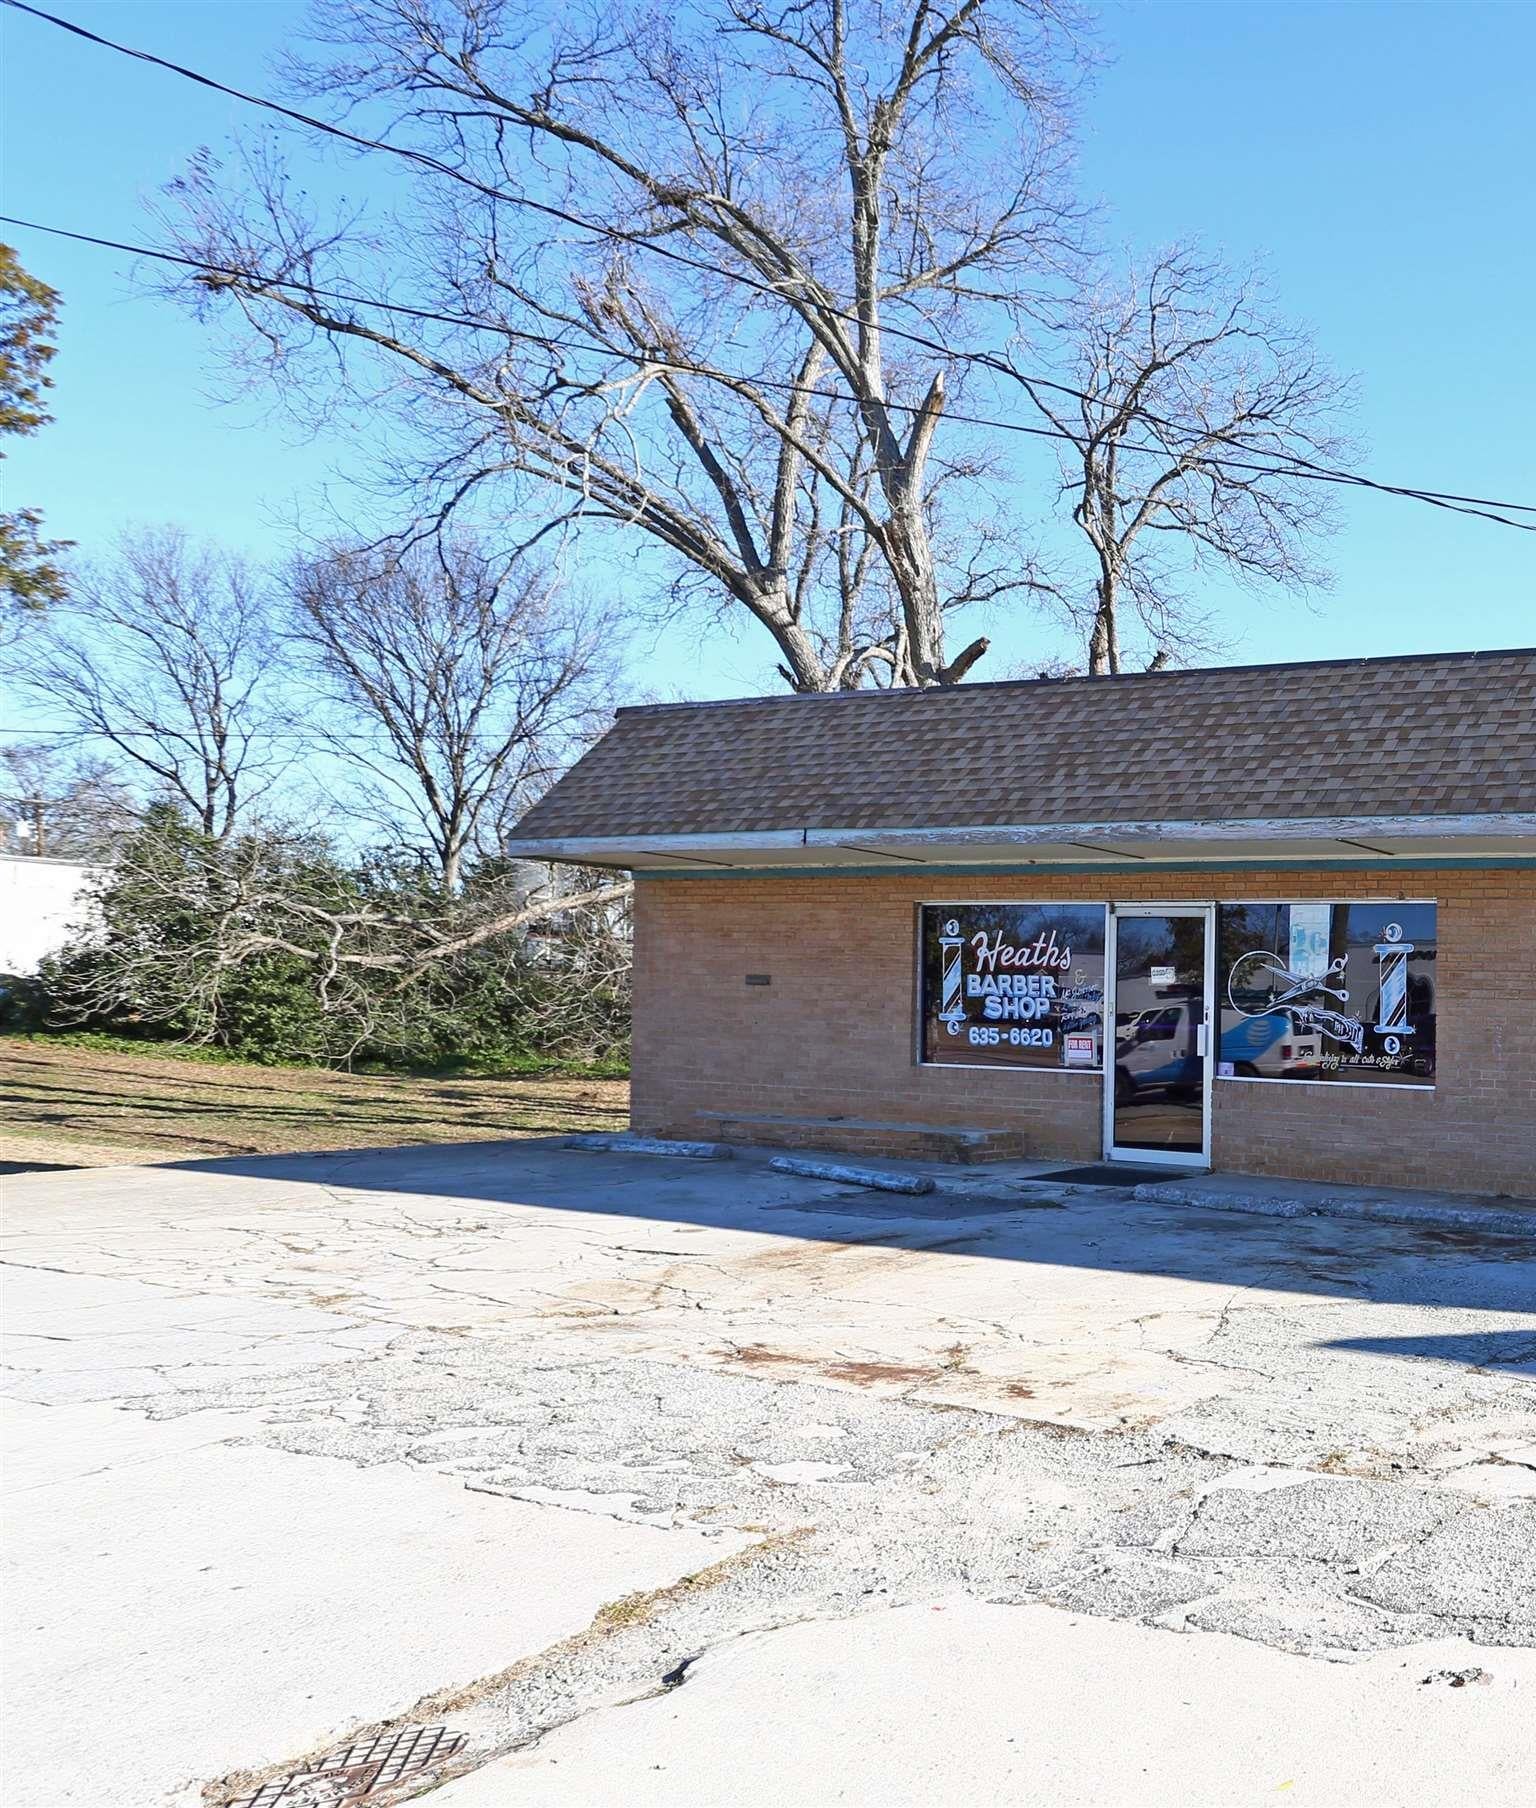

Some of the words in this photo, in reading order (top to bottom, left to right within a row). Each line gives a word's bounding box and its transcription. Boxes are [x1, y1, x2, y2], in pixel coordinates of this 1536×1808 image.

[970, 929, 1072, 972] Heaths
[966, 974, 1057, 998] BARBER
[983, 995, 1051, 1020] SHOP
[968, 1026, 1054, 1048] 635-6620
